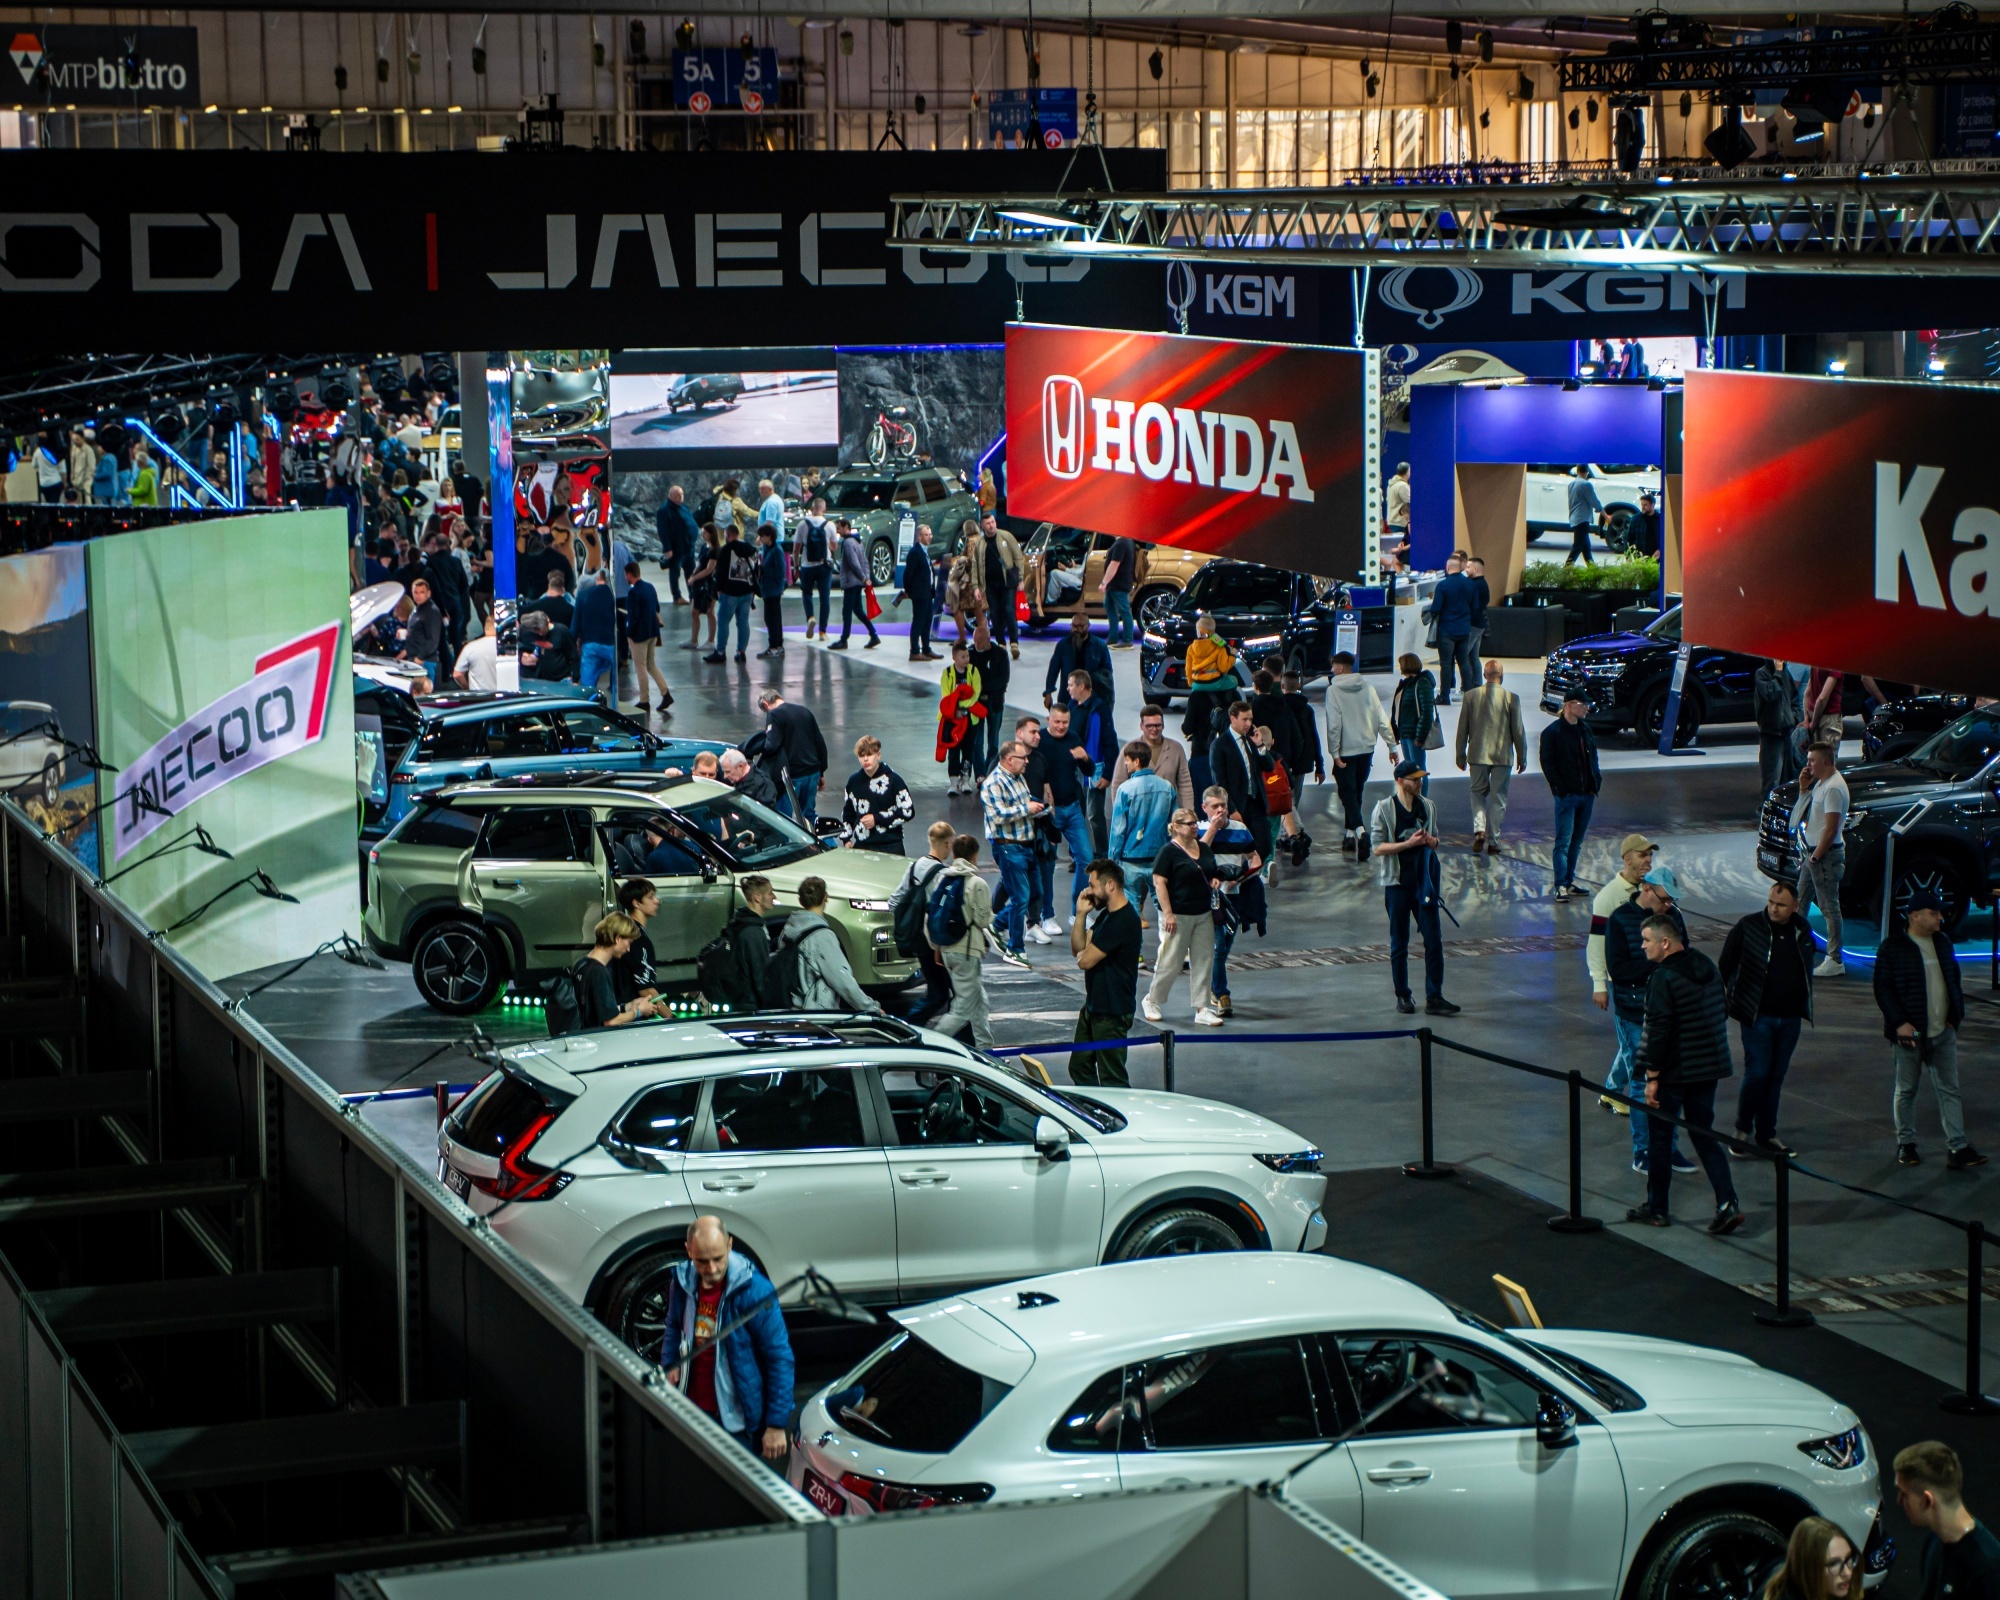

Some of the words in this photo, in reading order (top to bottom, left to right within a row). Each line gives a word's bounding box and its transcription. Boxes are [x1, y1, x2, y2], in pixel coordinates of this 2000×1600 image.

[49, 57, 187, 90] MTPbitro
[682, 56, 715, 82] 5A
[744, 56, 761, 82] 5
[0, 212, 373, 291] ODA
[1205, 274, 1295, 317] KGM
[1511, 271, 1746, 315] KGM
[1091, 397, 1315, 503] HONDA
[1875, 461, 2000, 619] Ka
[123, 685, 296, 835] JAECOO
[449, 1169, 465, 1190] CR-V
[808, 1478, 837, 1510] ZR-V
